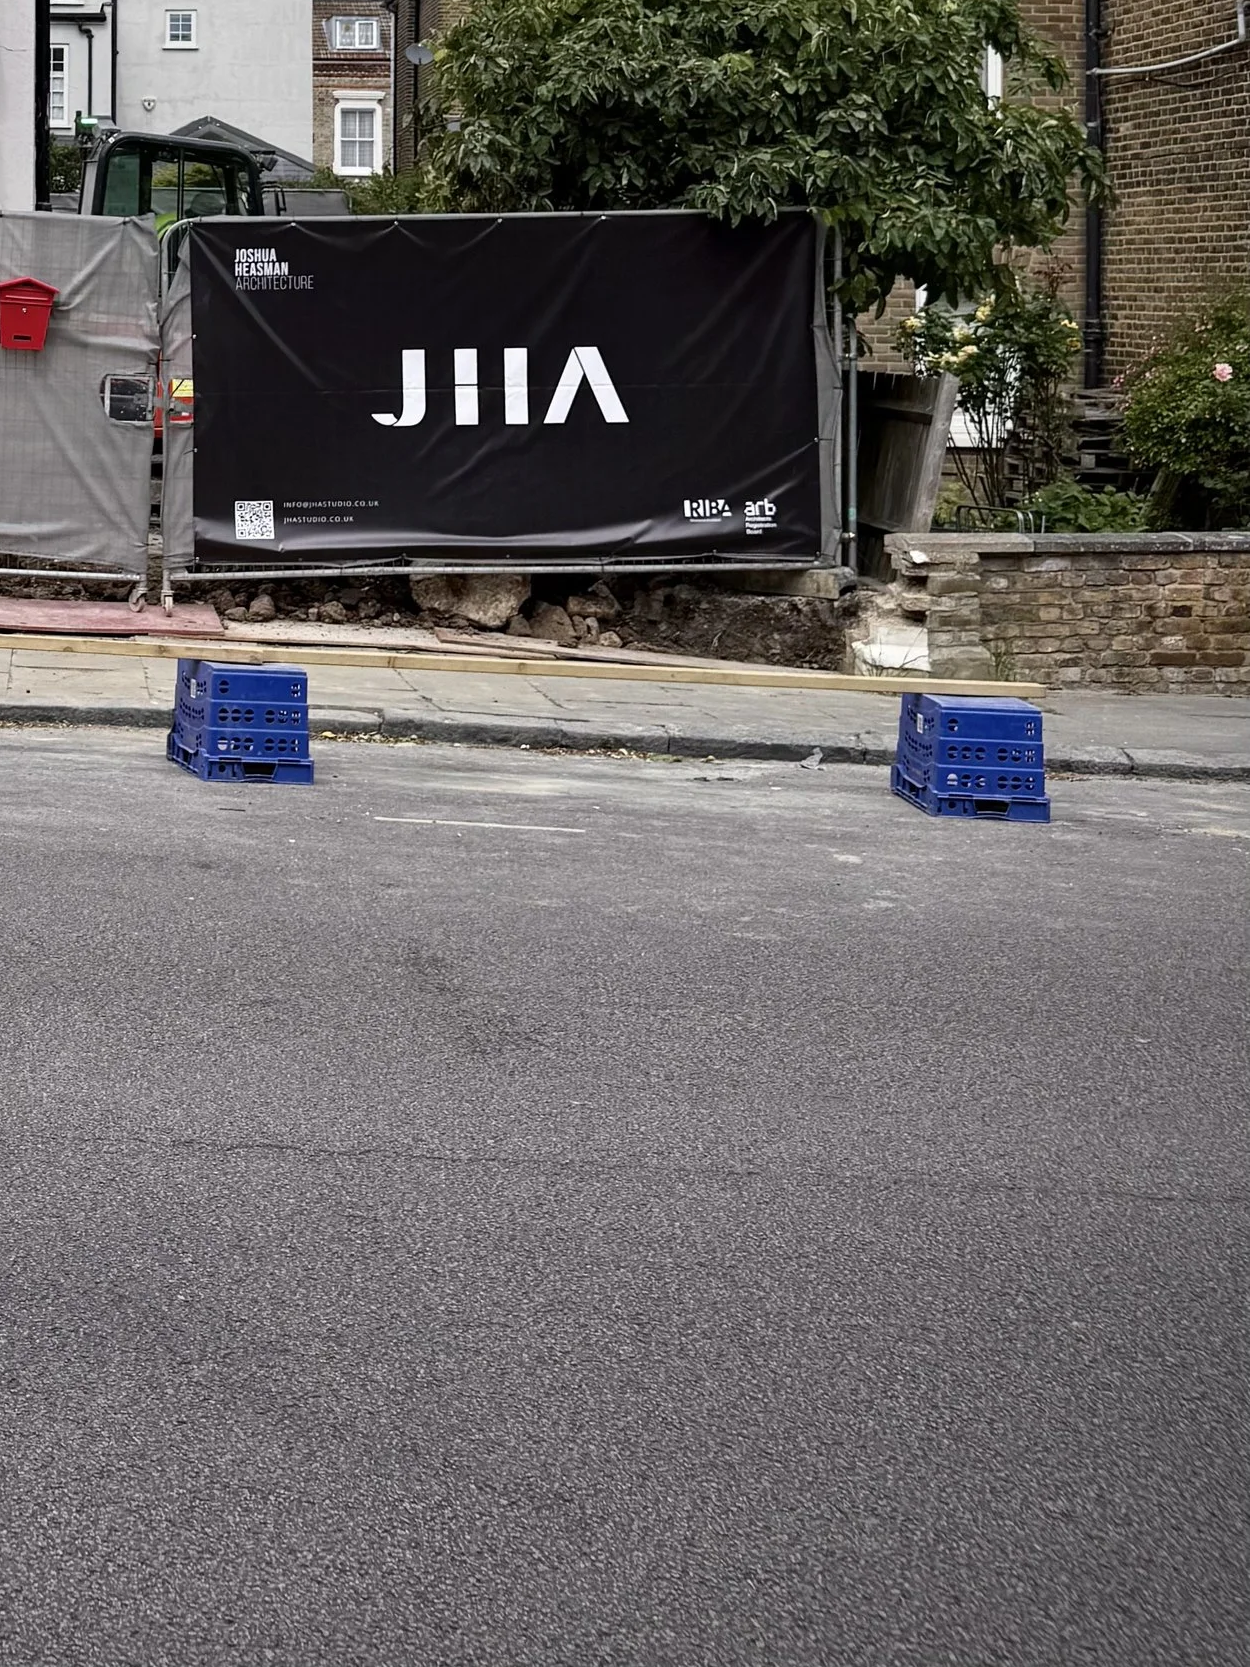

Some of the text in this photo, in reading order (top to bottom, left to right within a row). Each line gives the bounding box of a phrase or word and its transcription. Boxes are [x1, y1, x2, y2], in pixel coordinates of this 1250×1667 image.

[234, 248, 277, 262] JOSHUA
[235, 262, 289, 276] HEASMAN
[236, 275, 314, 290] ARCHITECTURE
[283, 500, 379, 509] INFO@JHASTUDIO.CO.UK
[683, 499, 732, 517] RIBA
[744, 498, 776, 516] arb
[283, 515, 354, 524] JHASTUDIO.CO.UK
